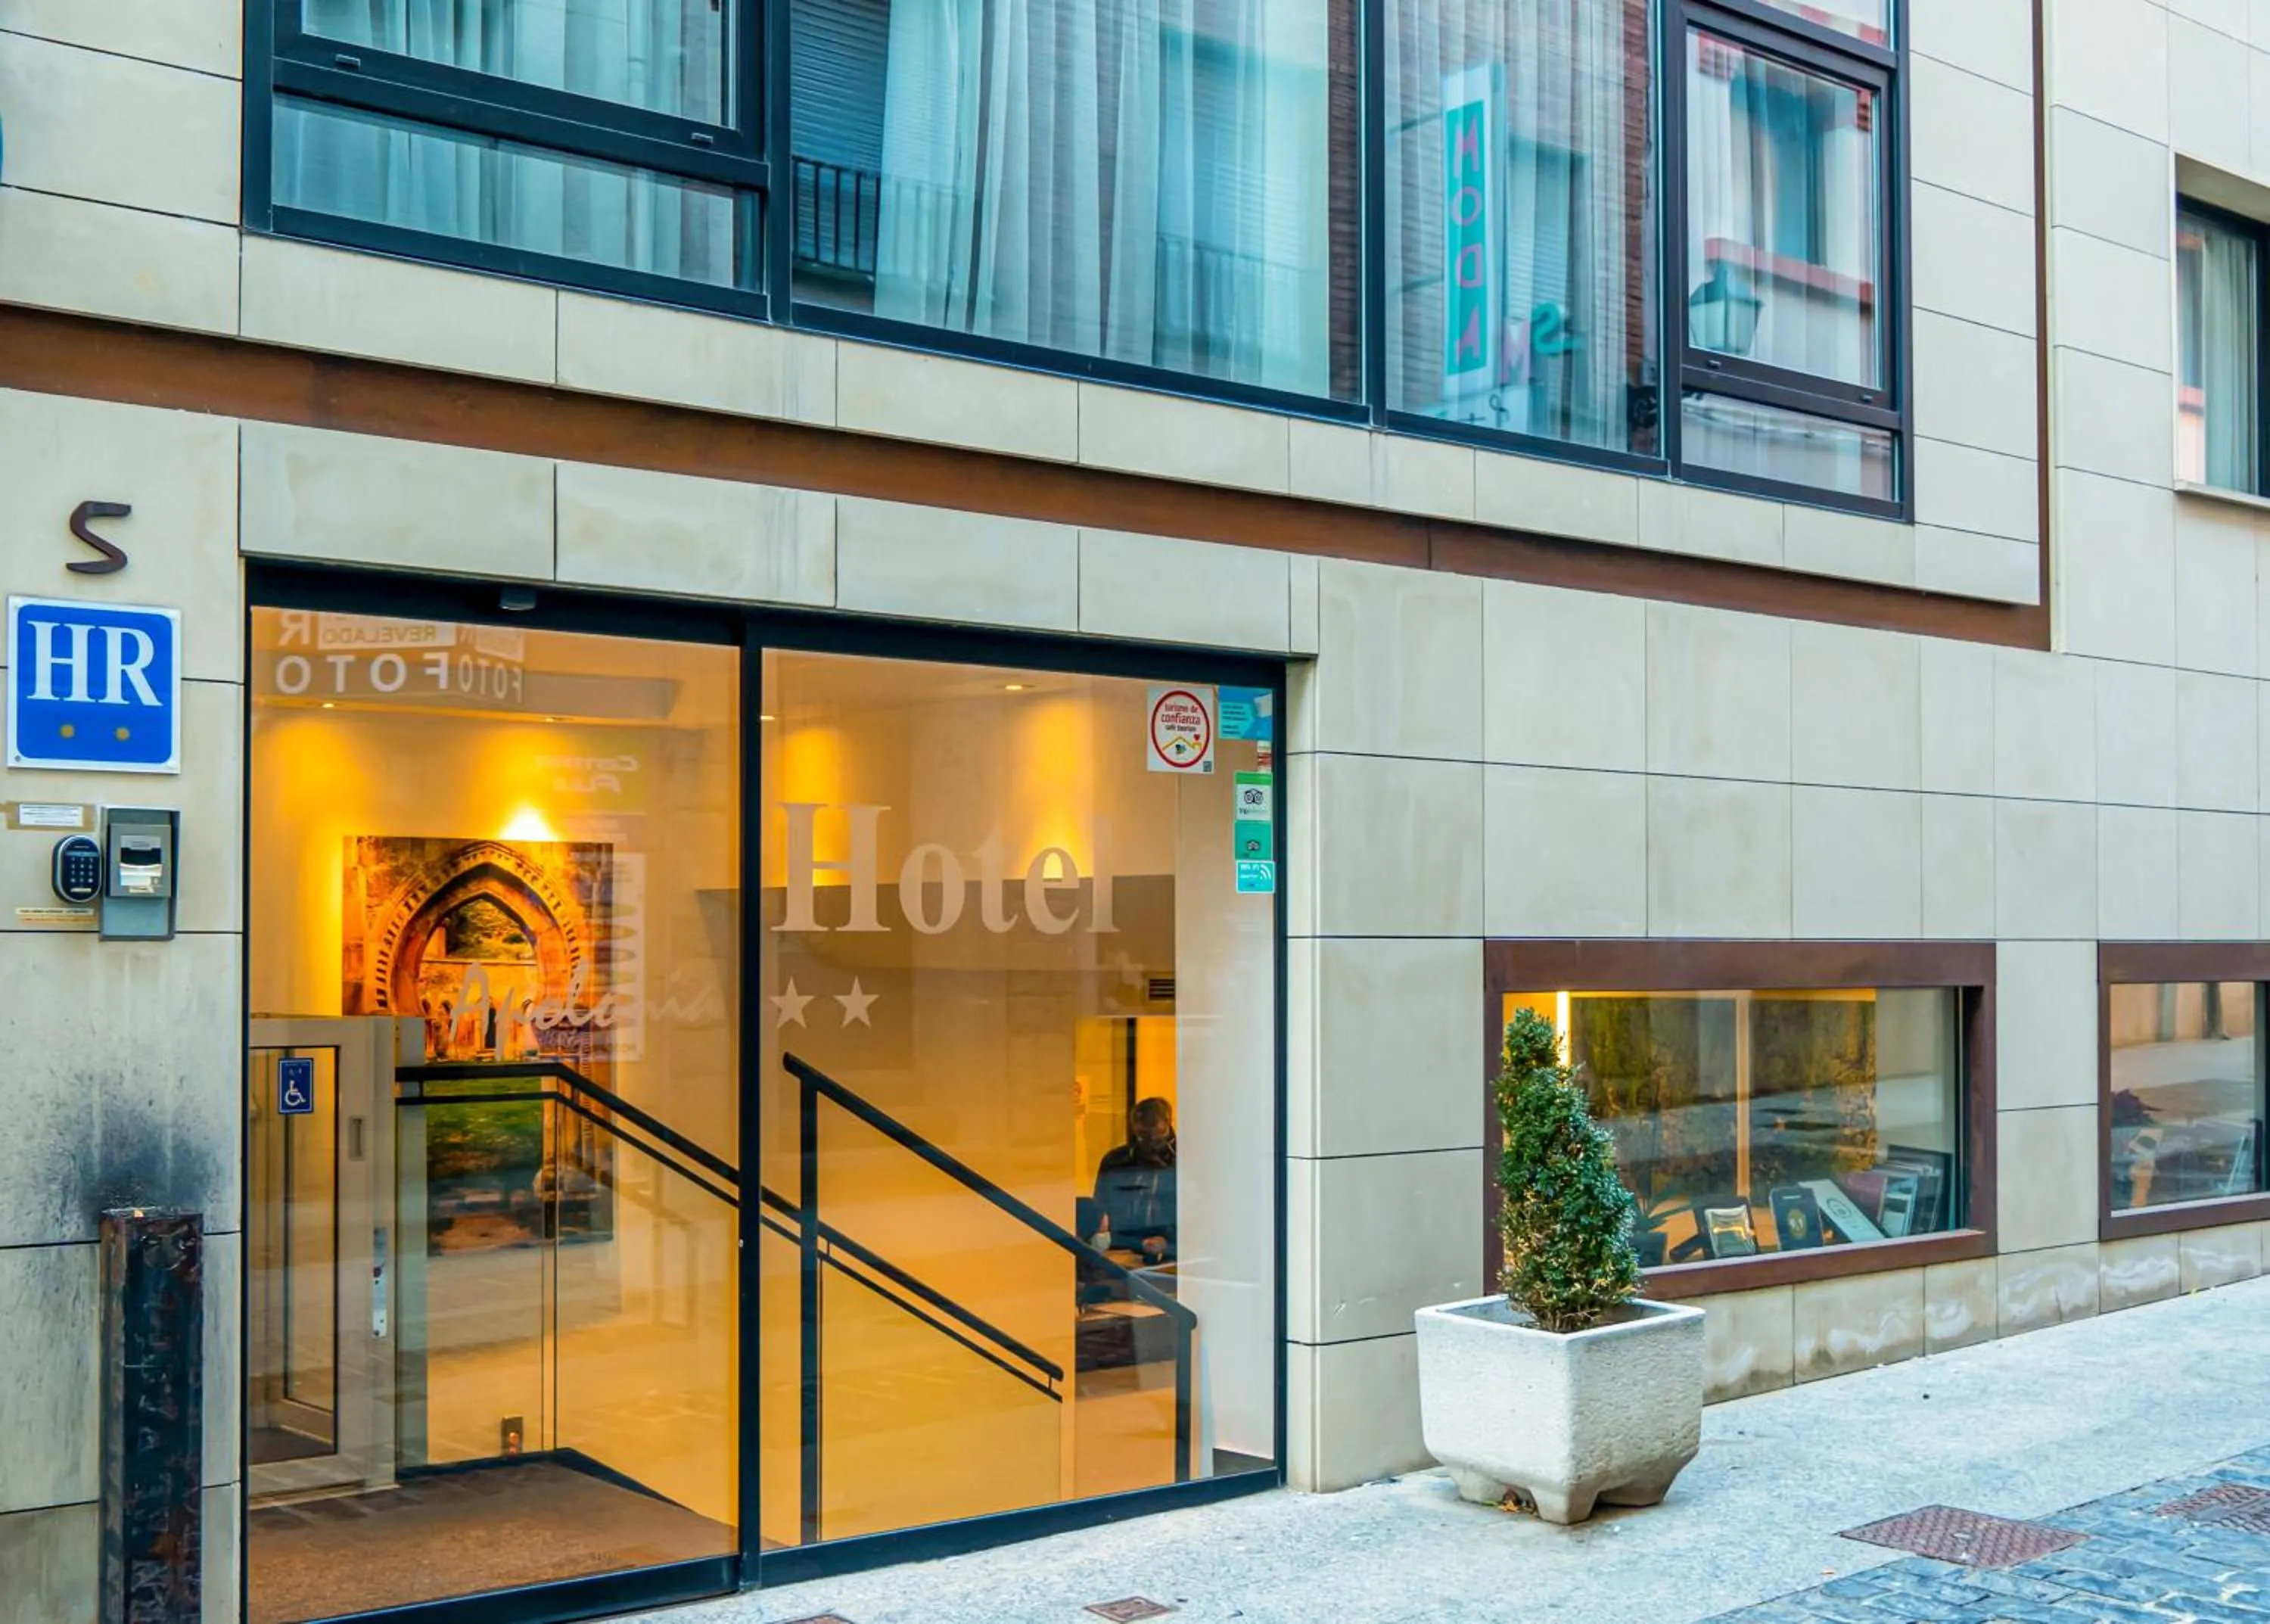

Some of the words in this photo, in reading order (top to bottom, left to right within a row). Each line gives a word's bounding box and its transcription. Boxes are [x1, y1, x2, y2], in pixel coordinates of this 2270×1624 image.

[26, 621, 163, 707] HR
[1161, 713, 1201, 725] confianza
[770, 803, 1120, 935] Hotel
